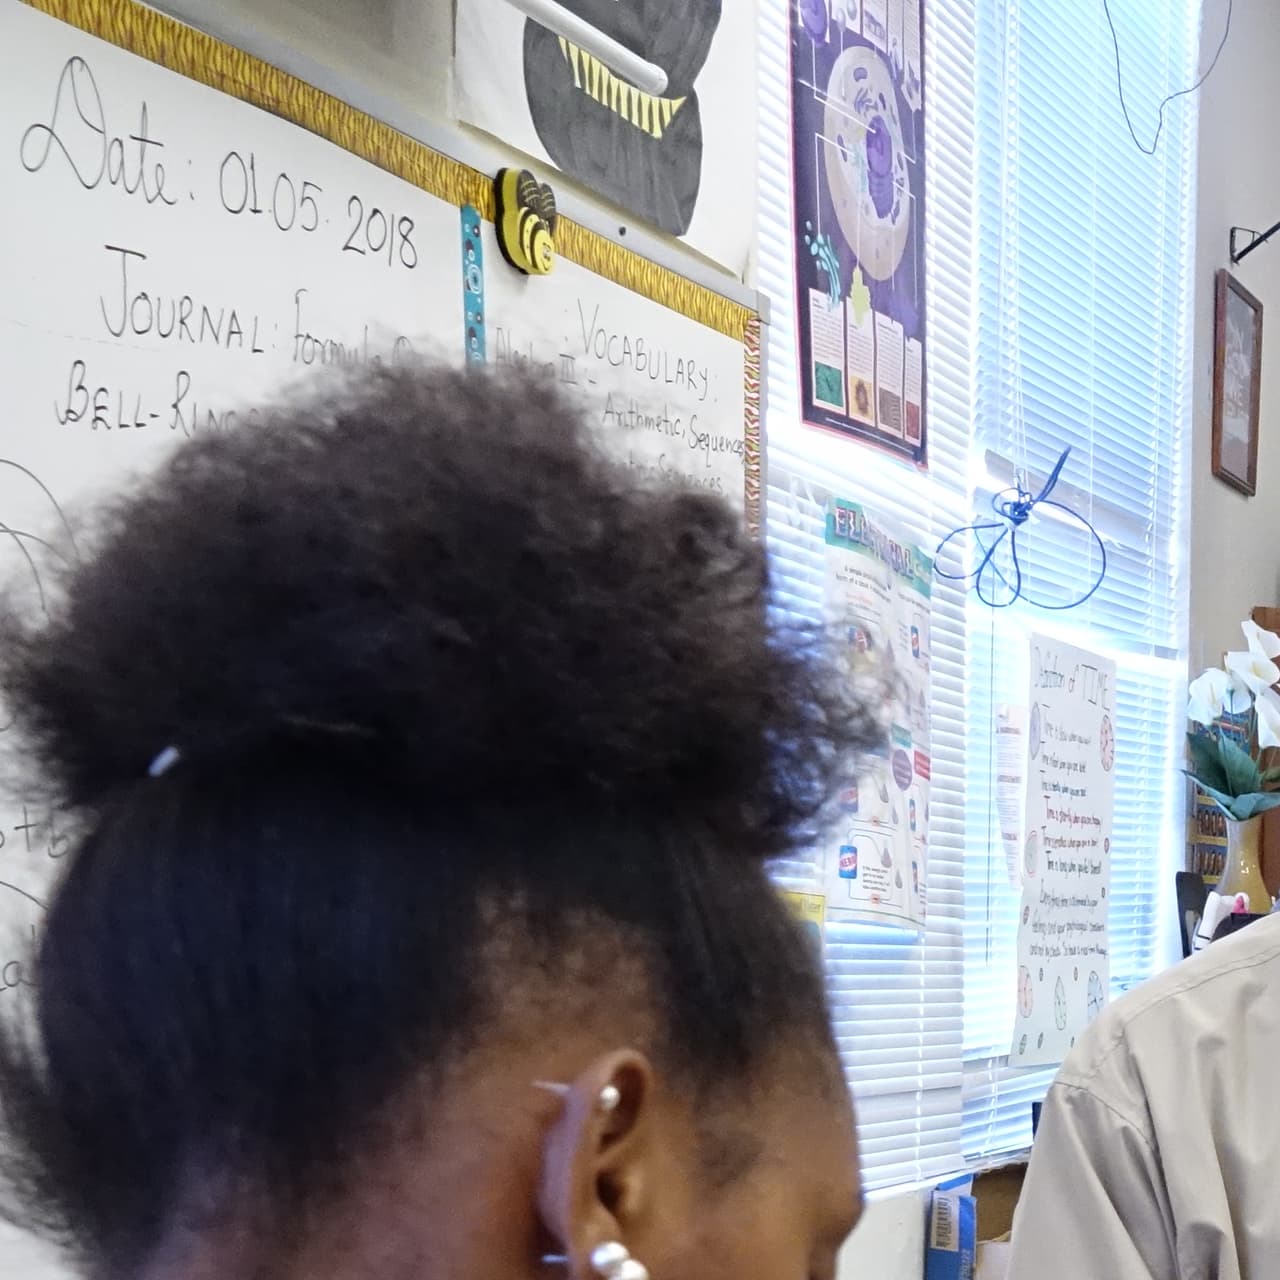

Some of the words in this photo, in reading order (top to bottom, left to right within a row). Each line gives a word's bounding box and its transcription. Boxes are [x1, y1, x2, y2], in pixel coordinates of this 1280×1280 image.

[20, 55, 196, 206] Date:
[342, 195, 418, 269] 2018
[100, 244, 278, 354] JOURNAL:
